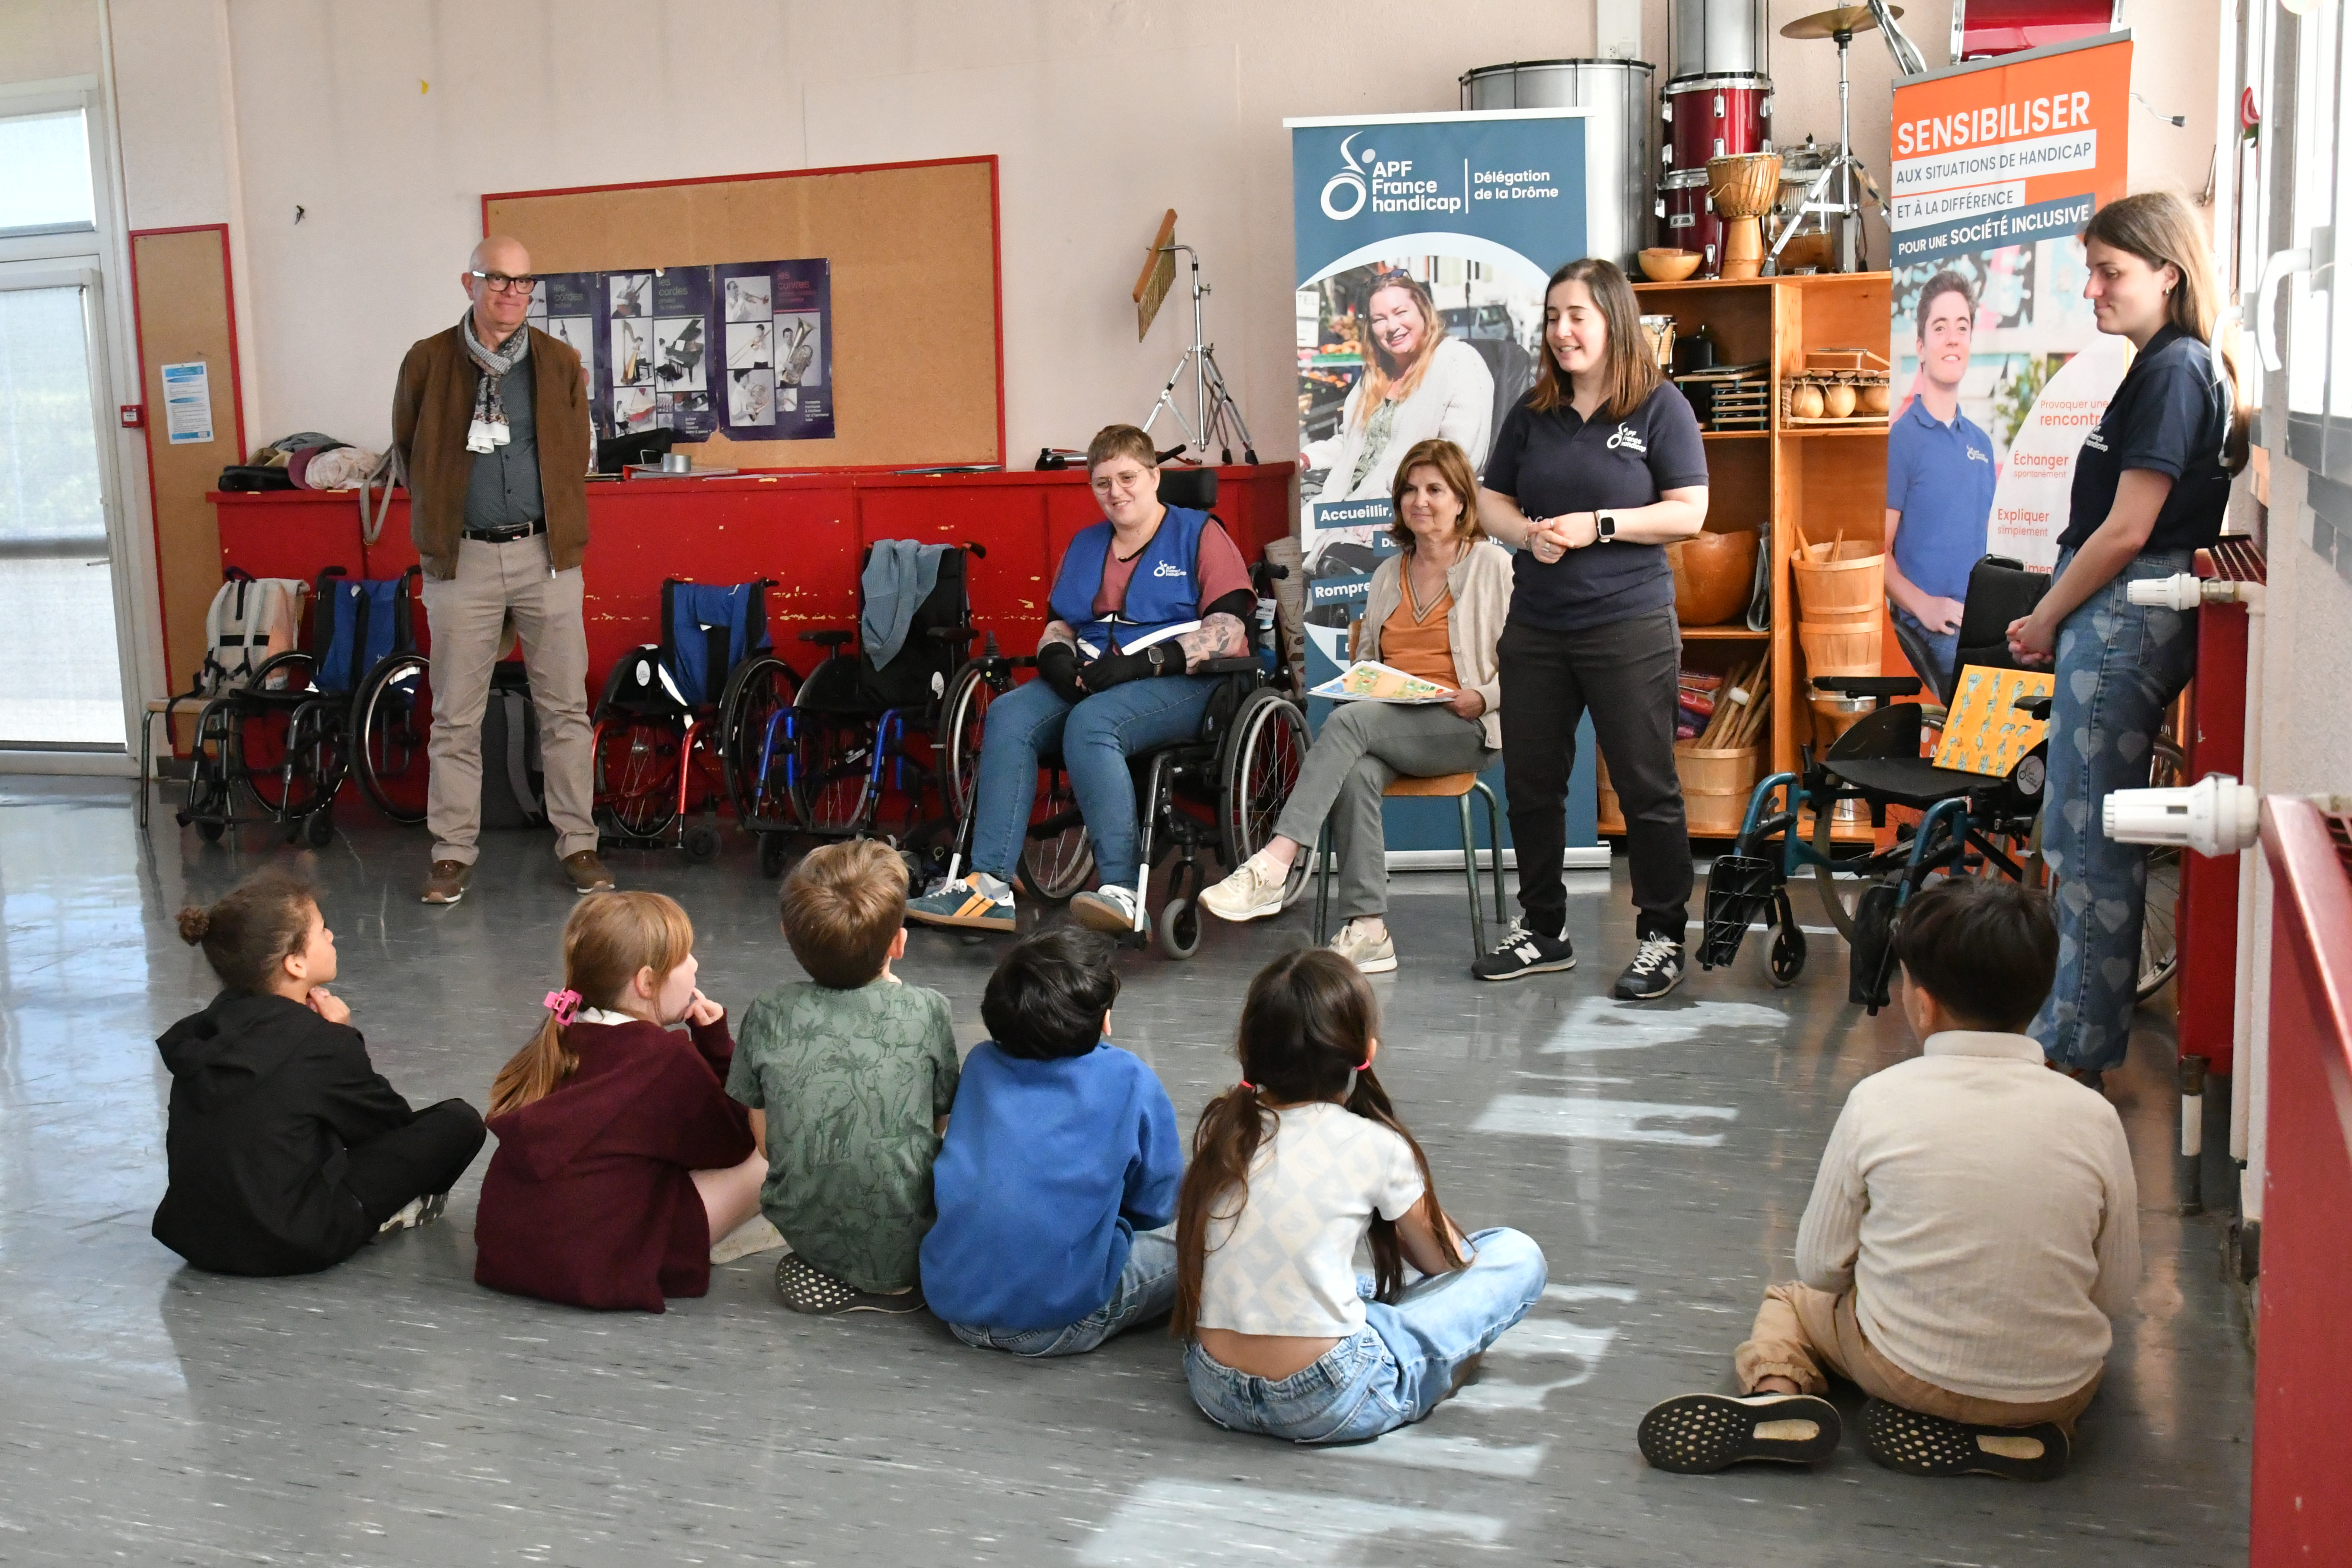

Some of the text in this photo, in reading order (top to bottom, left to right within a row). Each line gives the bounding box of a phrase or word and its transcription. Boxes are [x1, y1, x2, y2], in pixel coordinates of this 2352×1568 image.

[1898, 91, 2090, 154] SENSIBILISER
[1372, 161, 1413, 178] APF
[1896, 142, 2091, 184] AUX SITUATIONS DE HANDICAP
[1474, 169, 1550, 186] Délégation
[1372, 179, 1437, 195] France
[1474, 186, 1559, 200] de la Drôme
[1372, 194, 1461, 214] handicap
[1897, 190, 2013, 218] ET À LA DIFFÉRENCE
[1899, 204, 2089, 255] POUR UNE SOCIÉTÉ INCLUSIVE
[2040, 400, 2088, 411] Provoquer
[2040, 412, 2100, 426] rencontr
[2014, 450, 2069, 470] Échanger
[2014, 470, 2066, 478] spontanément
[1320, 504, 1392, 522] Accueillir,
[1998, 508, 2050, 525] Expliquer
[1998, 525, 2048, 538] simplement
[1315, 582, 1370, 598] Rompre
